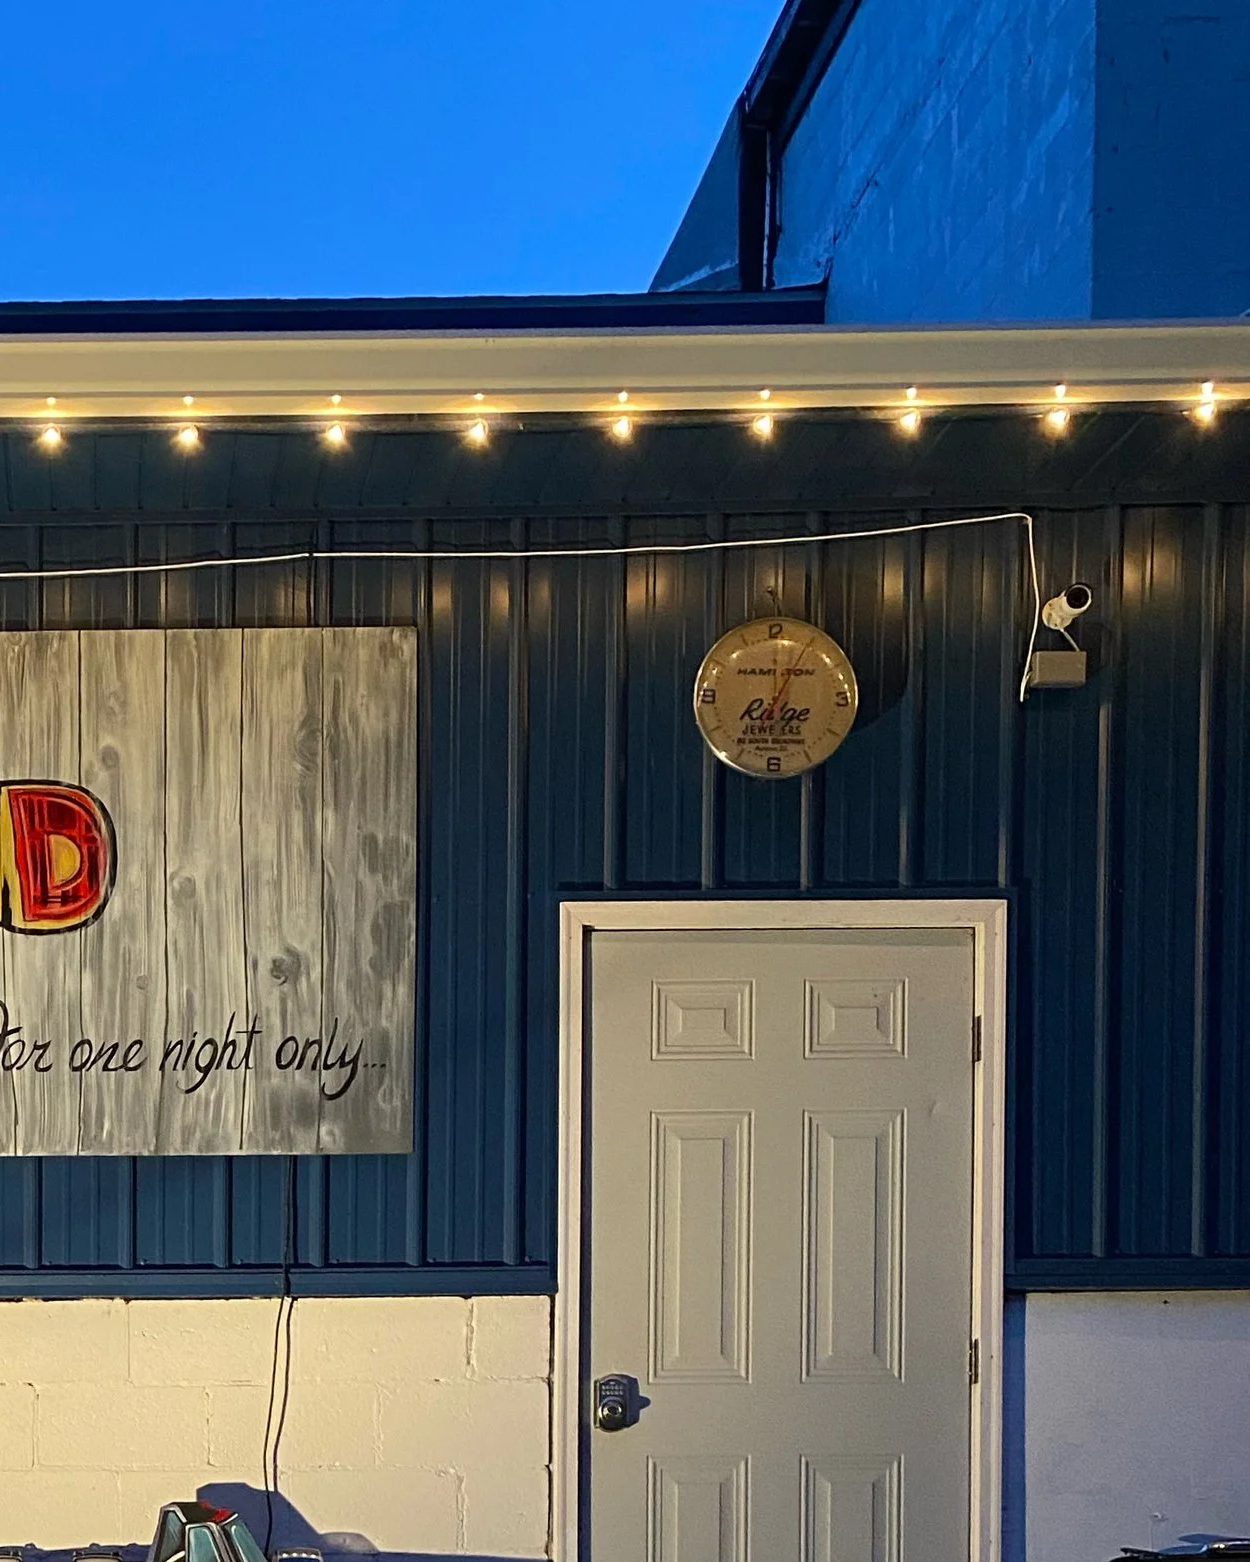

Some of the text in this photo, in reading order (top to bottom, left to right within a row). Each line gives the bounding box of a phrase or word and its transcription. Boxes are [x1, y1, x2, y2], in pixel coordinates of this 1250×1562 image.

[769, 623, 783, 639] 12
[835, 691, 849, 707] 3
[741, 724, 802, 736] JEWEERS
[766, 756, 781, 772] 6
[68, 1035, 149, 1073] one
[158, 1010, 264, 1095] night
[274, 1017, 387, 1101] only...
